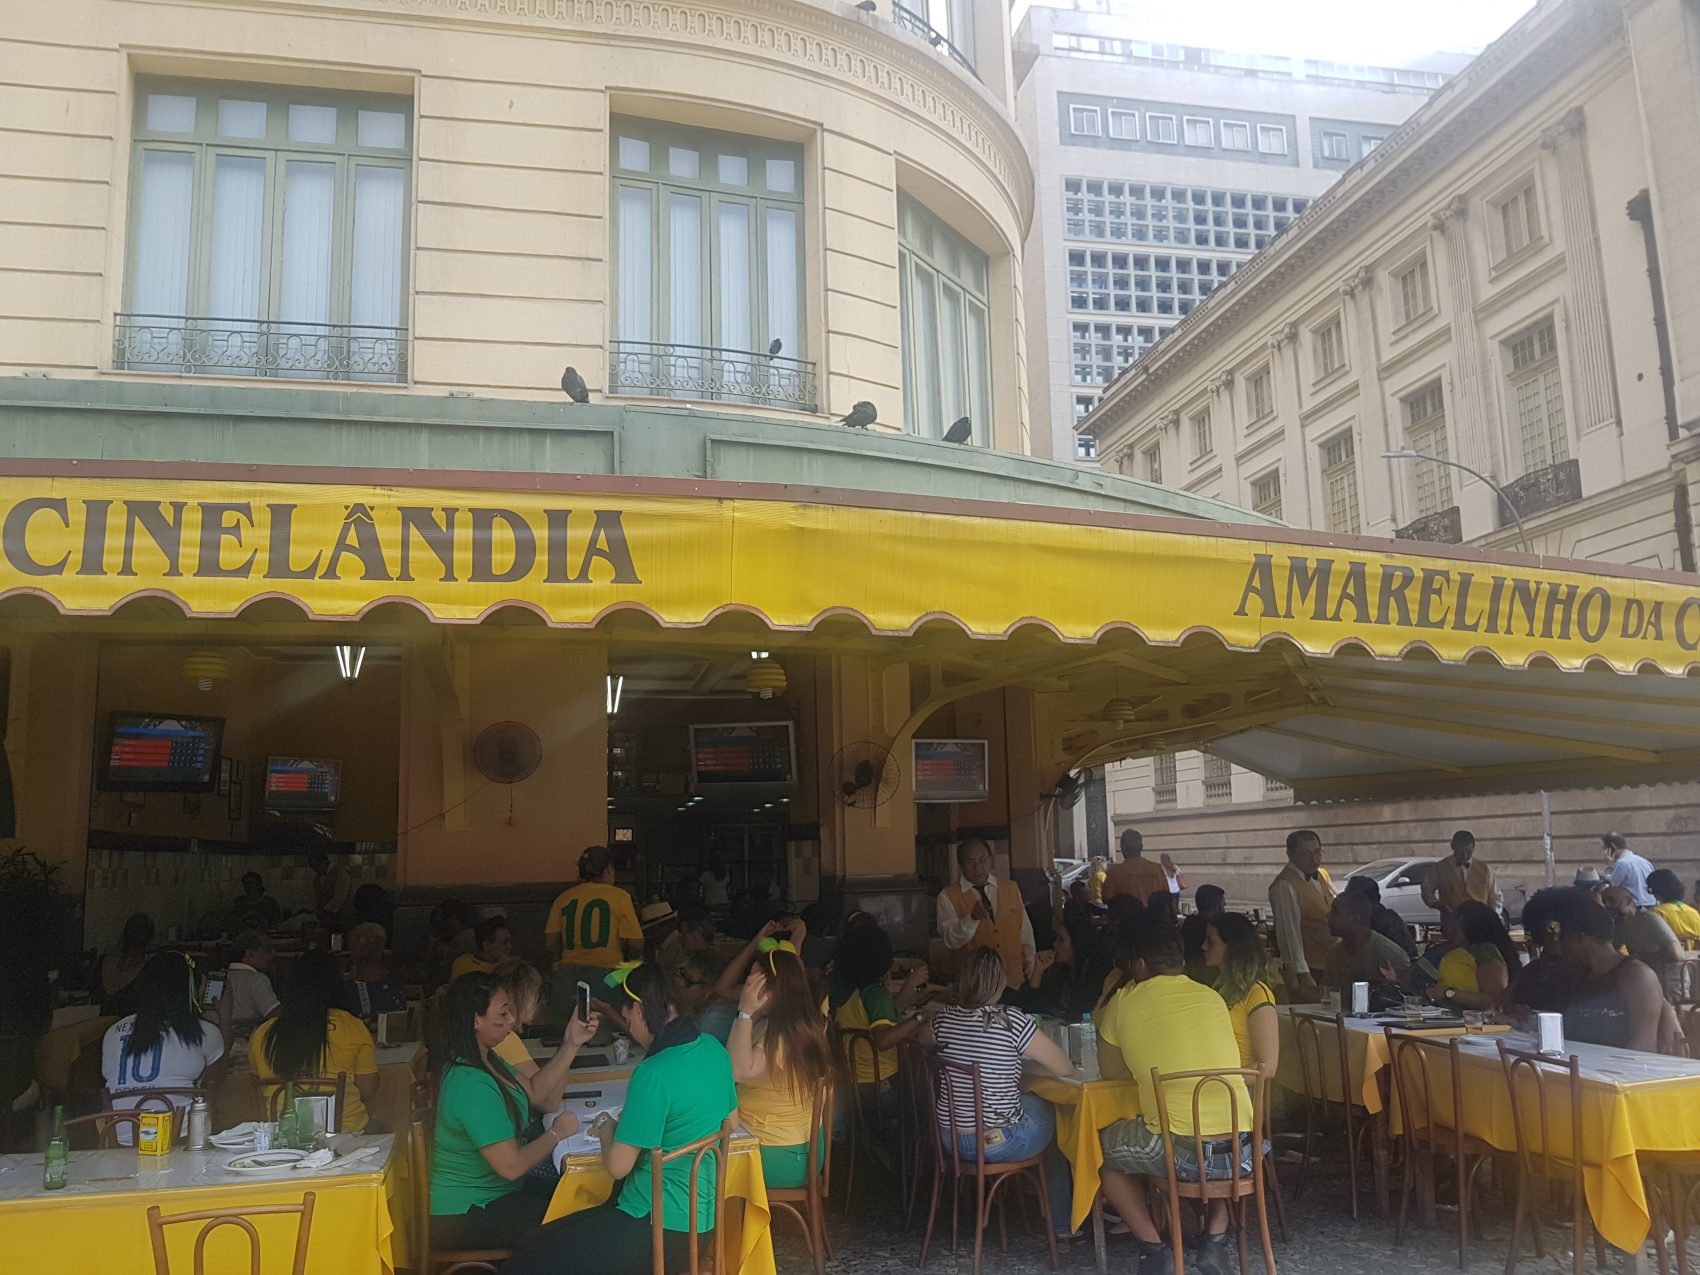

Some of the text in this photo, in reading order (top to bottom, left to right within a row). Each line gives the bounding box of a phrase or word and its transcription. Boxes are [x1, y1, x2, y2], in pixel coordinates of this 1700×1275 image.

[2, 496, 643, 585] CINELÂNDIA
[1233, 553, 1611, 644] AMARELINHO
[1620, 597, 1665, 642] DA
[560, 898, 611, 950] 10
[117, 1034, 165, 1086] 10
